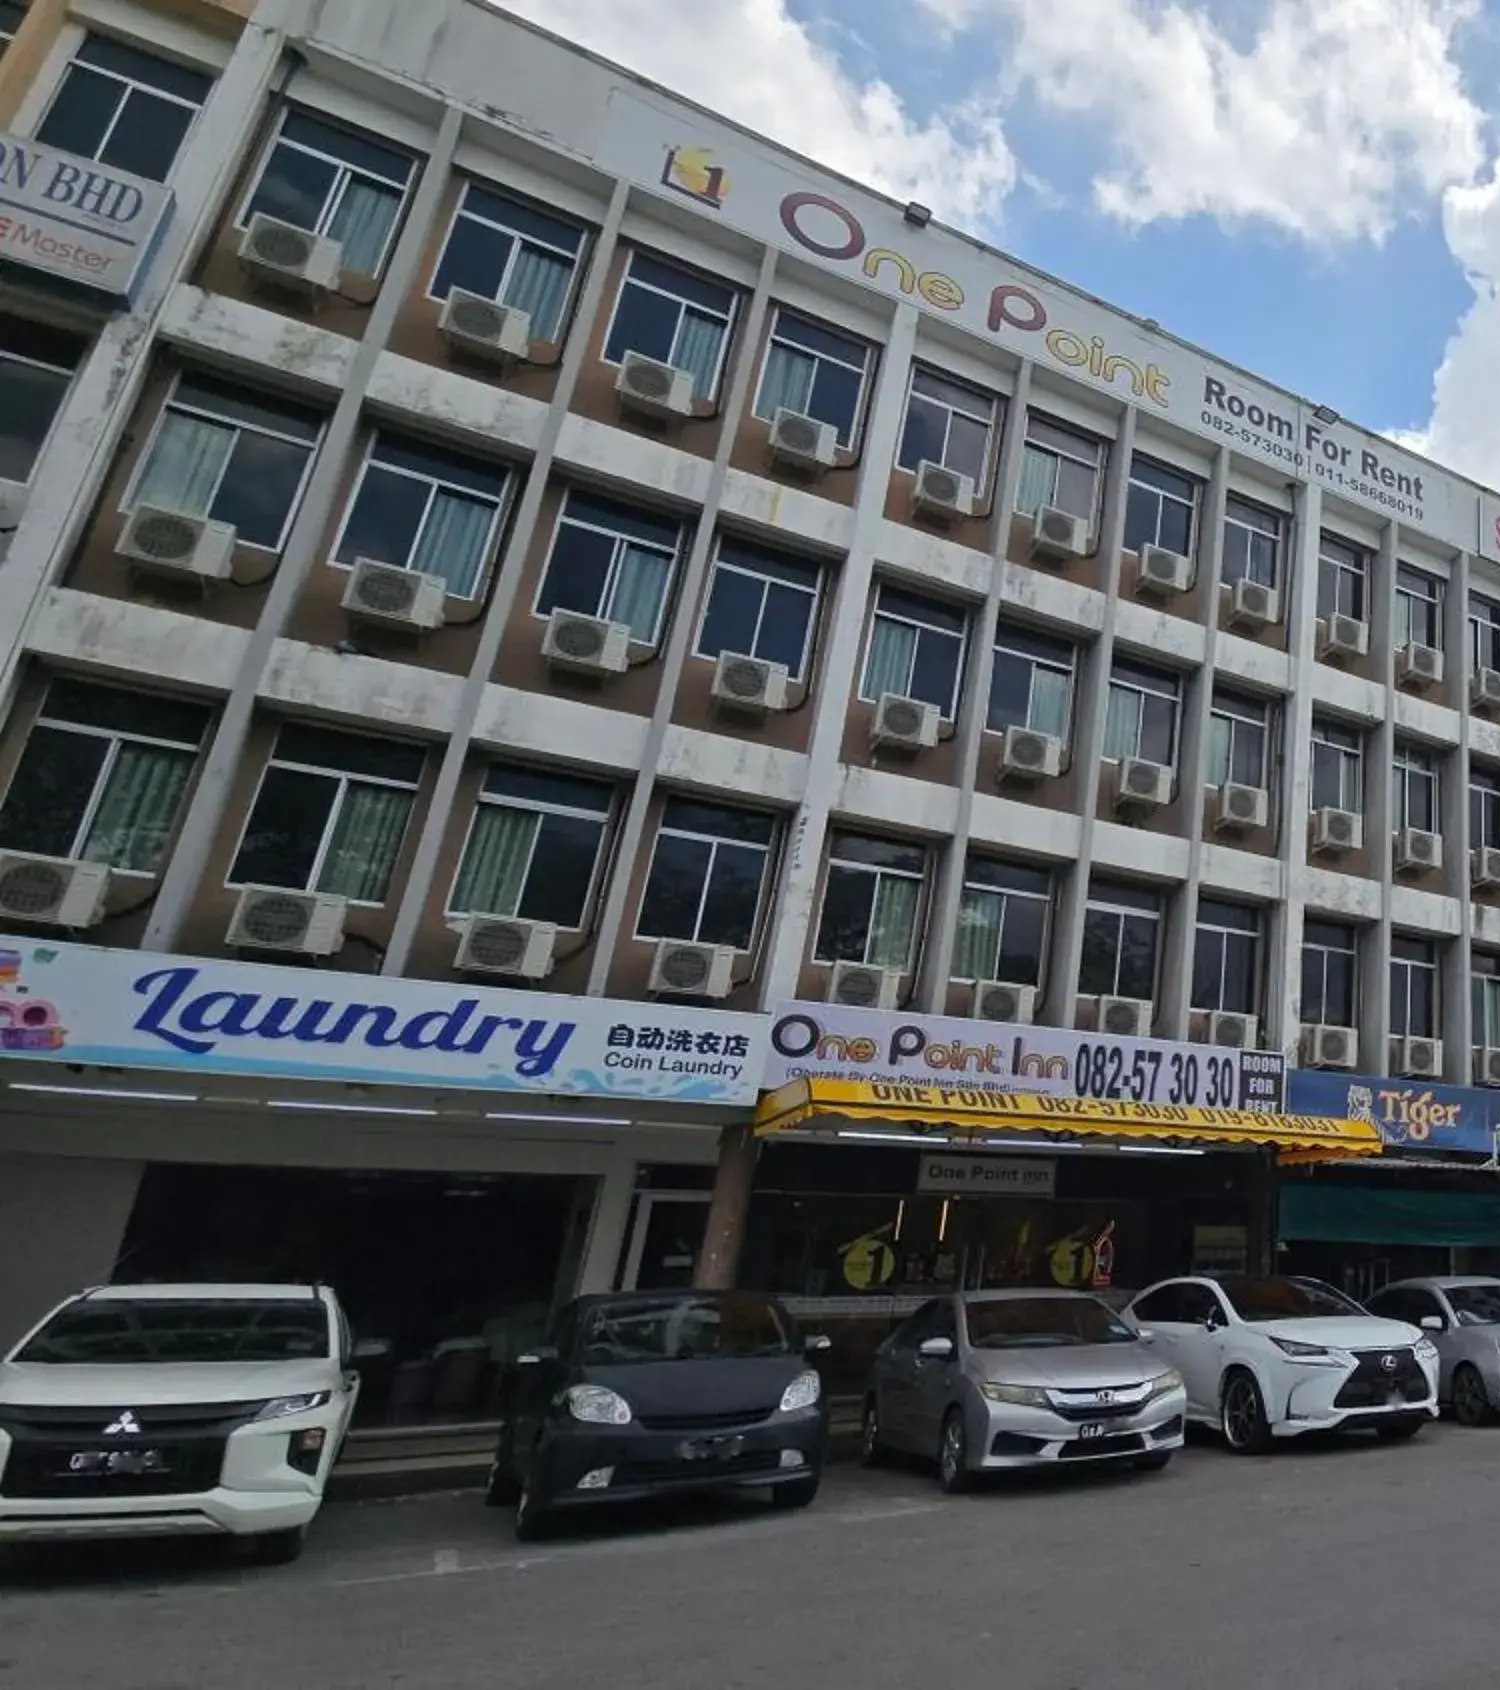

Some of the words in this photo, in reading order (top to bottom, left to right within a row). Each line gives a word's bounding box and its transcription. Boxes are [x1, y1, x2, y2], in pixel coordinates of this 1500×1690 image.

[0, 141, 44, 190] N
[41, 161, 144, 223] BHD
[11, 222, 114, 271] Master
[780, 191, 965, 311] One
[987, 284, 1172, 408] Point
[1200, 410, 1304, 468] 082-573030
[1203, 376, 1294, 441] Room
[1305, 422, 1352, 468] For
[1361, 449, 1424, 501] Rent
[132, 967, 577, 1078] Laundry
[606, 1023, 750, 1058] 自动洗衣店
[771, 1013, 877, 1064] One
[888, 1025, 1002, 1075] Point
[1010, 1036, 1069, 1081] Inn
[604, 1051, 653, 1071] Coin
[658, 1056, 744, 1081] Laundry
[1074, 1043, 1163, 1103] 082-57
[1169, 1053, 1199, 1106] 30
[1205, 1055, 1234, 1108] 30
[1242, 1055, 1282, 1074] ROOM
[1249, 1077, 1275, 1095] FOR
[1377, 1089, 1462, 1141] Tiger
[927, 1163, 966, 1181] One
[970, 1164, 1019, 1182] Point
